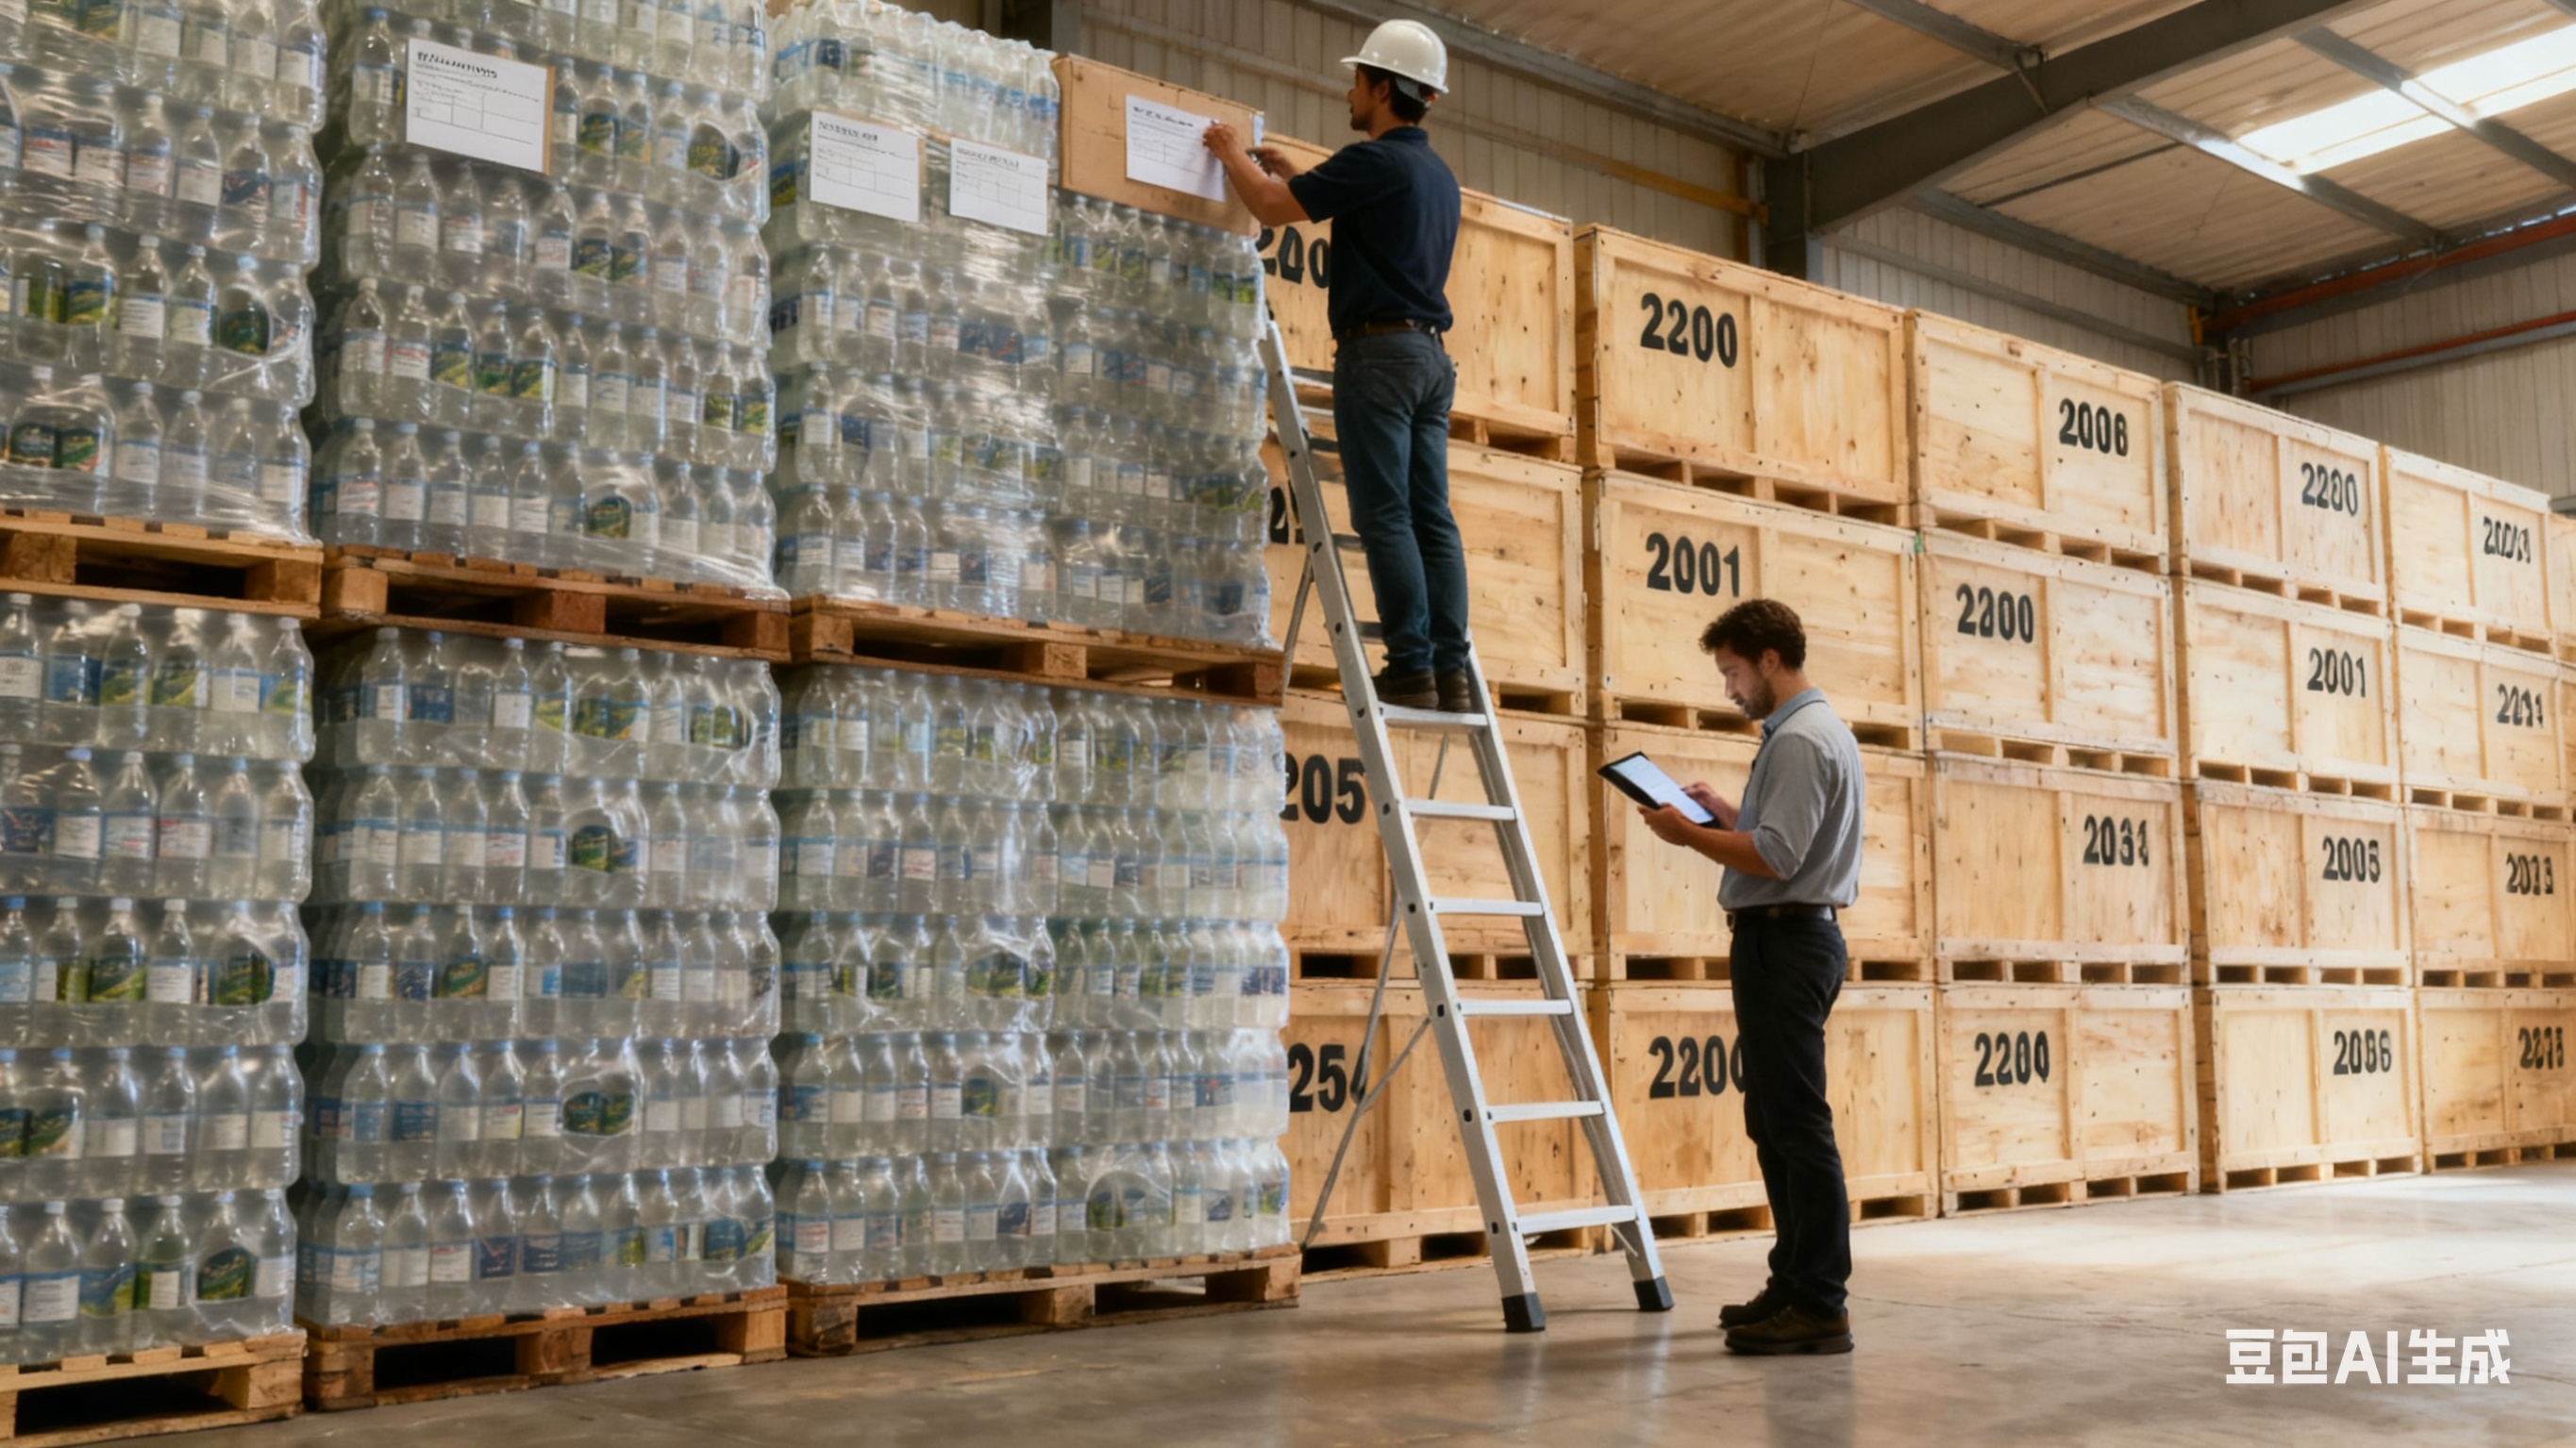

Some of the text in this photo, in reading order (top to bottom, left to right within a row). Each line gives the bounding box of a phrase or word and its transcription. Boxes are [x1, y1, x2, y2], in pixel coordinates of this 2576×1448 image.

[1641, 291, 1738, 369] 2200
[1645, 531, 1741, 598] 2001
[2306, 647, 2367, 698] 2001
